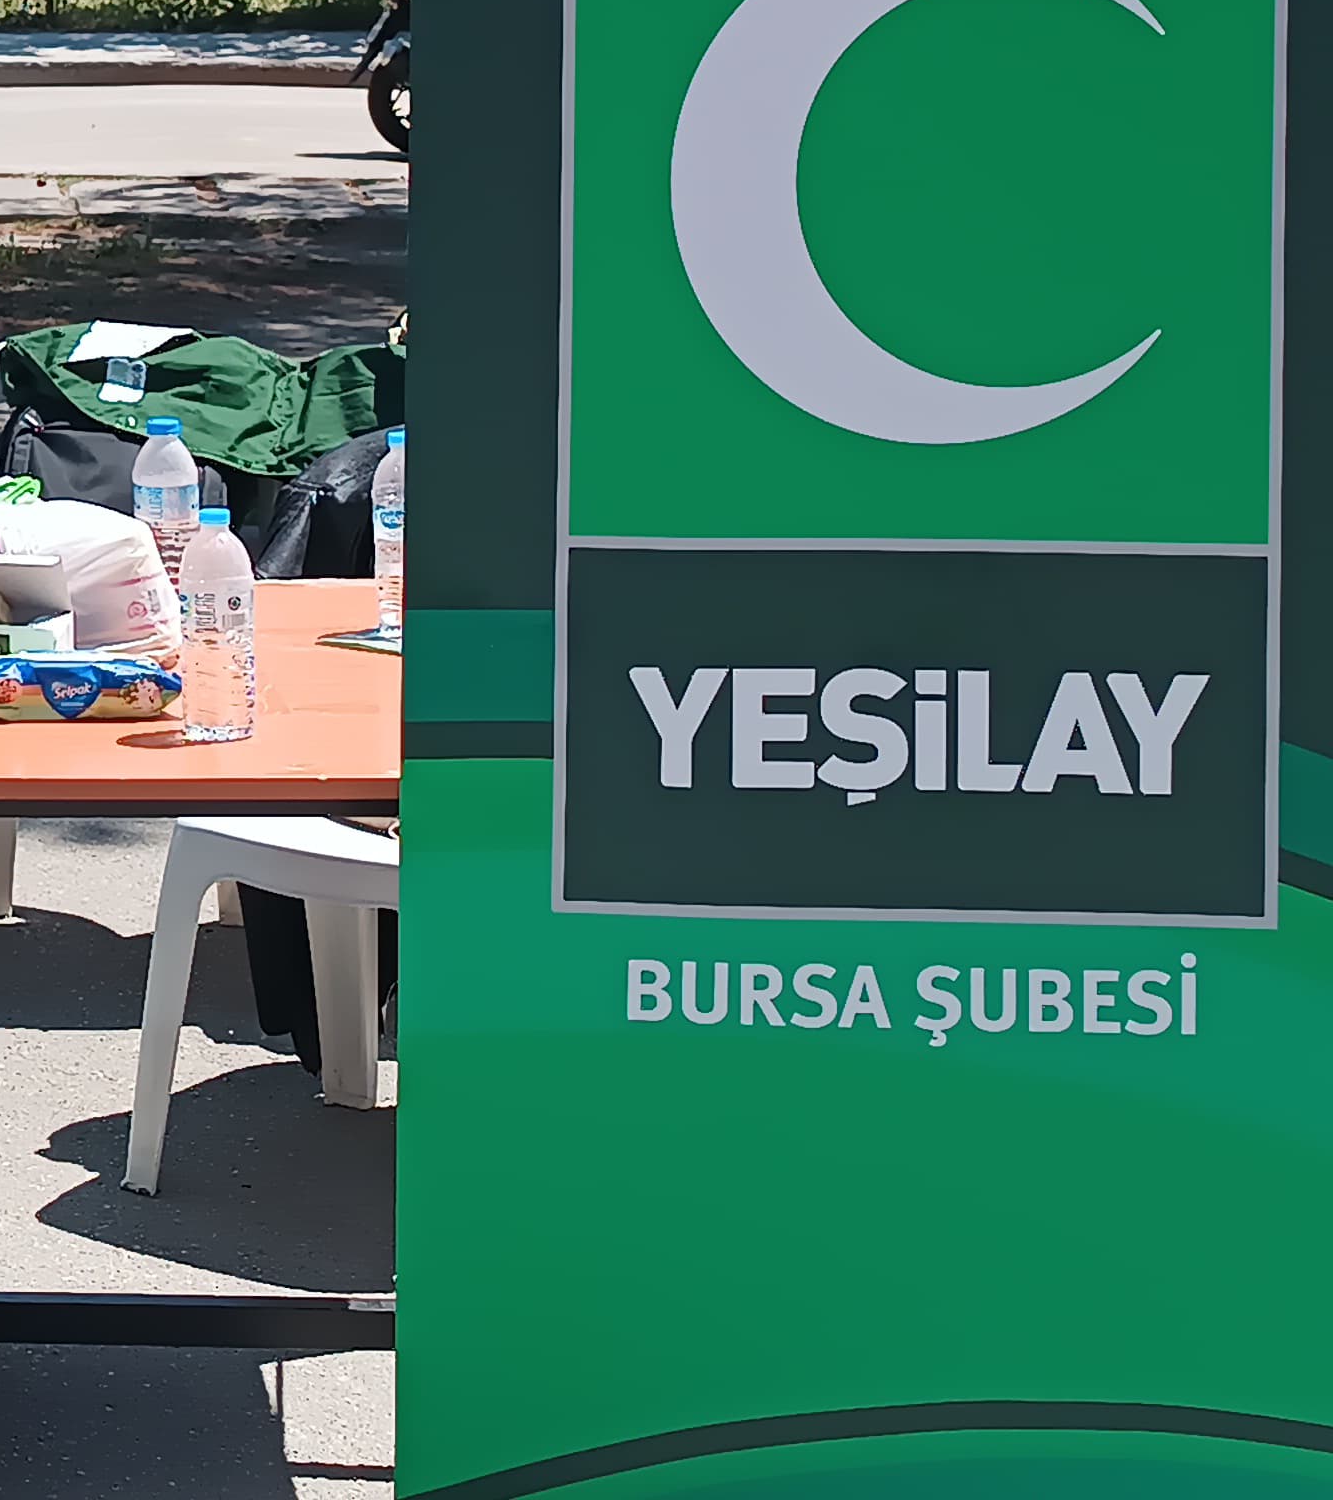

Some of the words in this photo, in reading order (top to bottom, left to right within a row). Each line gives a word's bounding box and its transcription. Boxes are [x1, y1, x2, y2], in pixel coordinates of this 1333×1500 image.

[628, 666, 1212, 807] YEŞİLAY
[626, 958, 892, 1031] BURSA
[914, 952, 1198, 1049] ŞUBESİ
